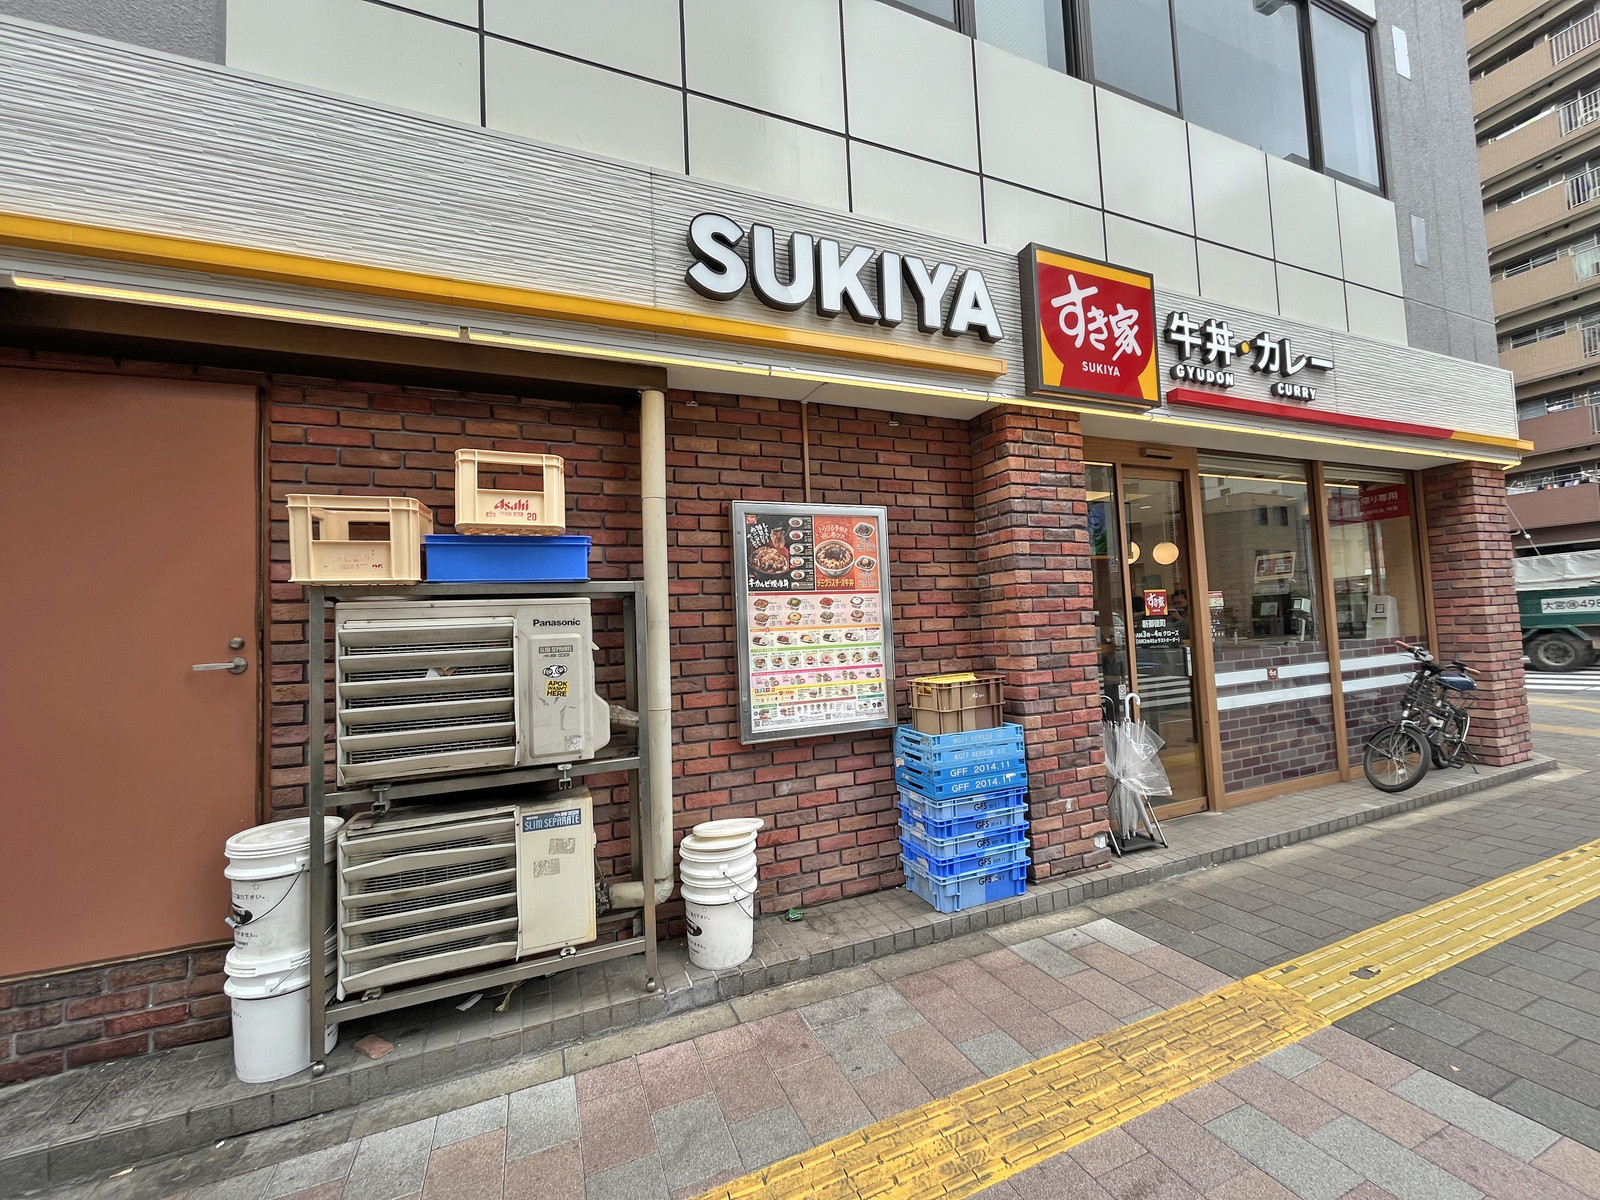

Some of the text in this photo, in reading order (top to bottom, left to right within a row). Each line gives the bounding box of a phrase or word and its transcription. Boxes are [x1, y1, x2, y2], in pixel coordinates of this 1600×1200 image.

[684, 211, 1005, 343] SUKIYA
[1051, 274, 1142, 361] すき家
[1165, 311, 1334, 377] 牛丼・カレー
[1082, 361, 1120, 377] SUKIYA
[1172, 364, 1235, 388] GYUDON
[1272, 382, 1317, 401] CURRY
[494, 498, 529, 511] Asahi
[526, 512, 537, 521] 20
[1146, 593, 1166, 608] すき家
[533, 618, 581, 627] Panasonic
[950, 761, 1010, 777] GFF 2014.11
[951, 782, 970, 792] GFF
[974, 802, 988, 811] GFS
[525, 815, 580, 830] SLIM SEPARATE
[975, 820, 989, 829] GFS
[976, 838, 991, 848] GFS
[978, 857, 992, 867] GFS
[978, 875, 992, 885] GFS
